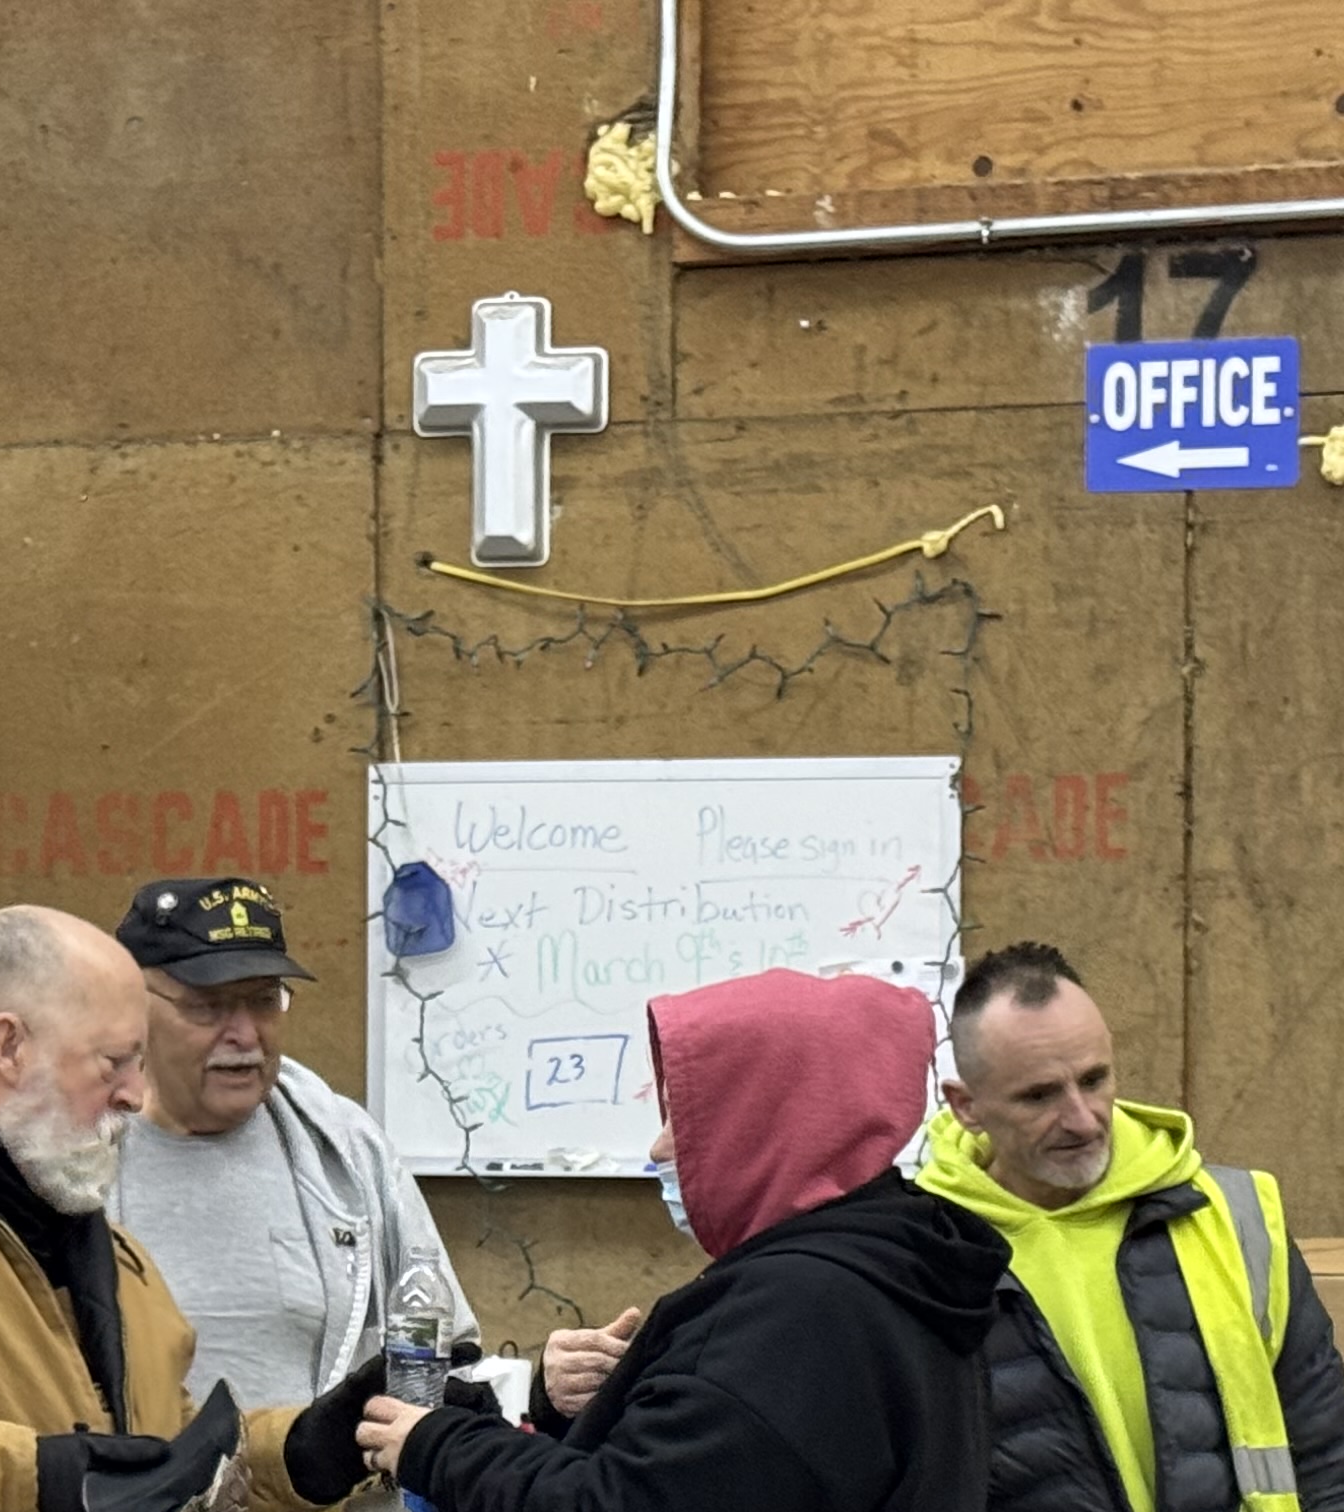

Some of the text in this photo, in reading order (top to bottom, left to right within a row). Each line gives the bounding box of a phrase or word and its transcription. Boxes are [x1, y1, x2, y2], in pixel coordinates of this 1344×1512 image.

[1086, 249, 1256, 342] 17
[1104, 360, 1282, 430] OFFICE
[455, 802, 903, 872] Welcome Please sign in
[199, 890, 229, 911] U.S.
[576, 882, 809, 926] Distribution
[547, 1054, 586, 1085] 23
